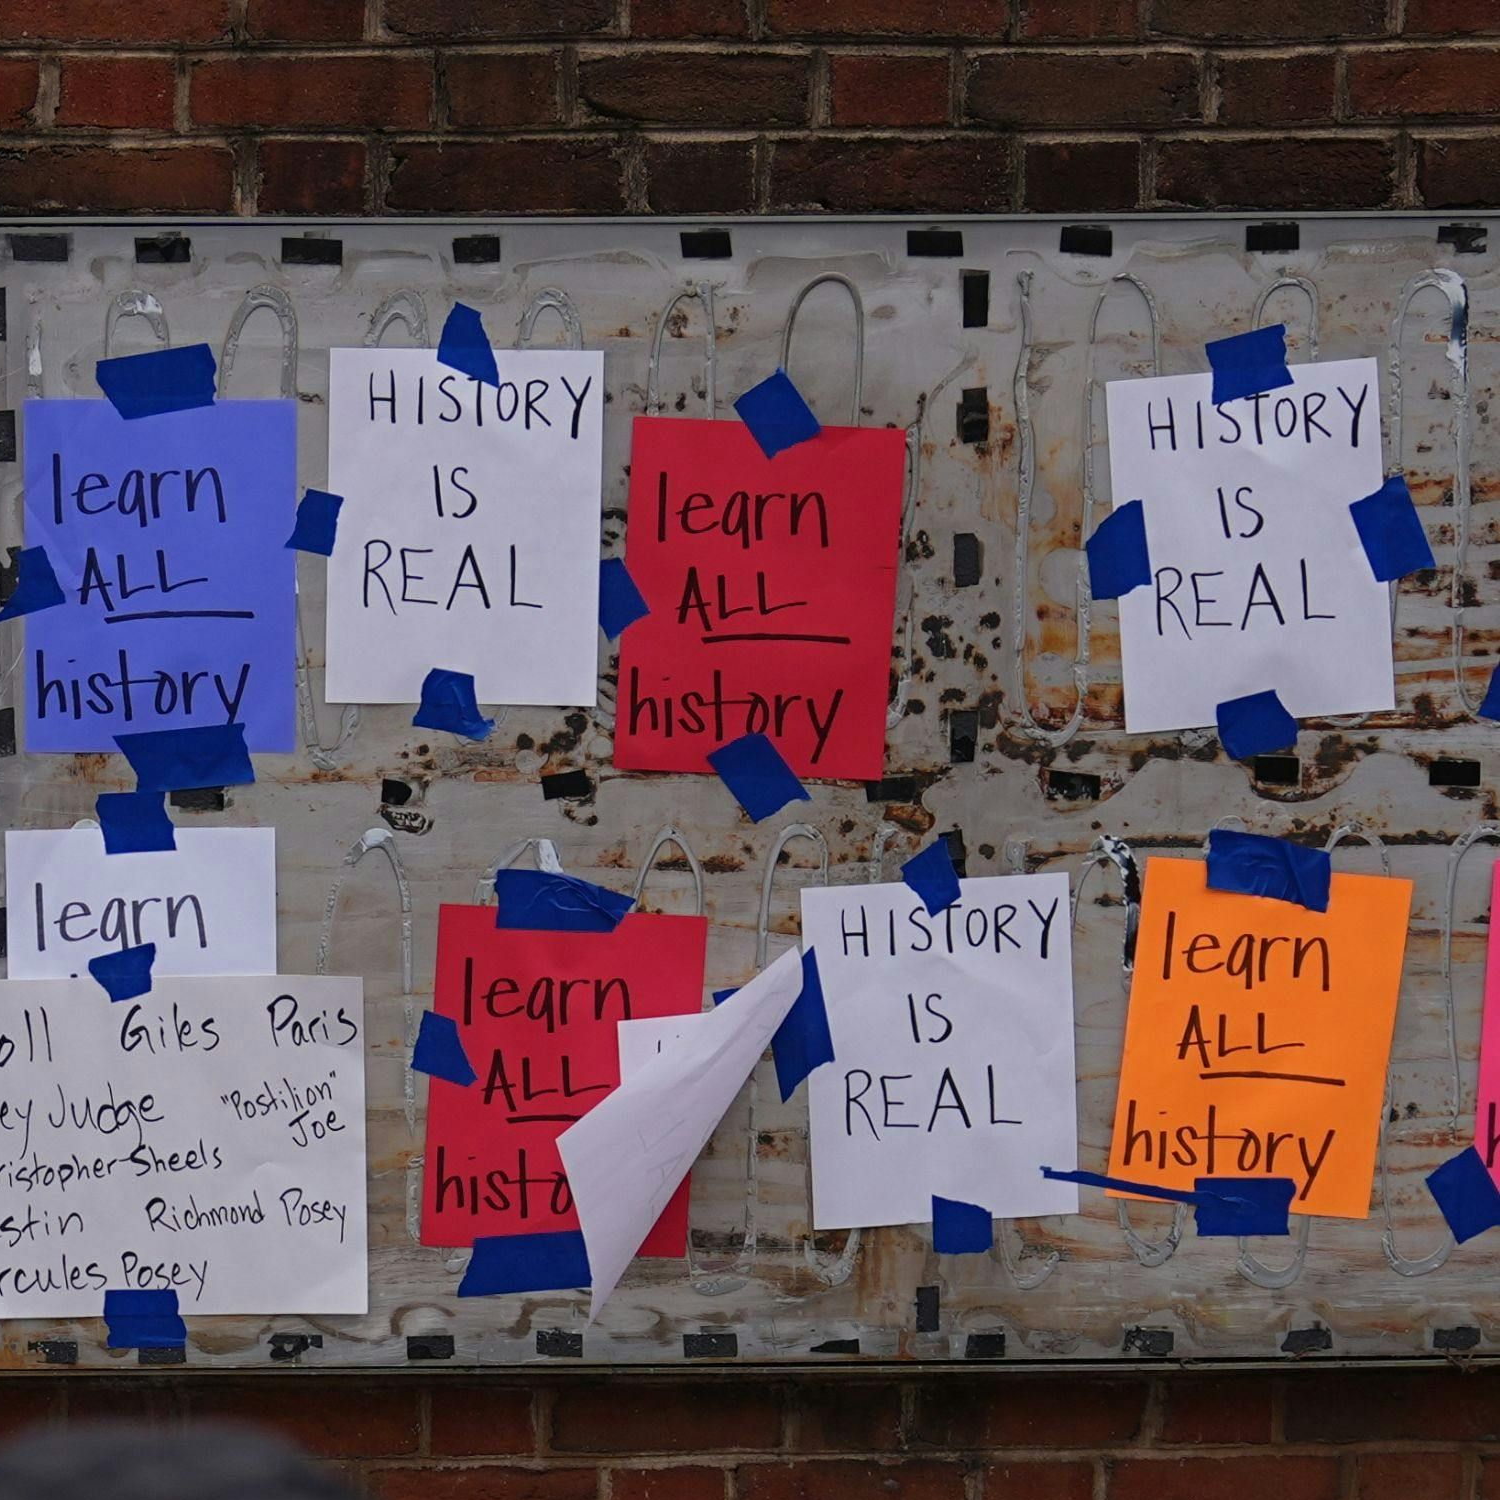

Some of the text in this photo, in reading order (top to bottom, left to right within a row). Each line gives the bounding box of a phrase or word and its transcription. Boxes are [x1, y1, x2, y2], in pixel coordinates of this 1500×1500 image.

[369, 372, 592, 438] HISTORY
[1148, 384, 1368, 450] HISTORY
[52, 454, 226, 527] learn
[434, 465, 477, 518] IS
[658, 473, 829, 549] learn
[1217, 487, 1263, 539] IS
[78, 549, 207, 611] ALL
[364, 539, 542, 614] REAL
[676, 568, 807, 630] ALL
[1156, 558, 1335, 638] REAL
[36, 650, 250, 724] history
[629, 666, 844, 764] history
[36, 883, 206, 950] learn
[841, 897, 1058, 959] HISTORY
[1163, 911, 1329, 992] learn
[267, 995, 357, 1046] Paris
[463, 957, 631, 1033] learn
[908, 993, 953, 1044] IS
[1175, 1004, 1304, 1068] ALL
[482, 1049, 611, 1112] ALL
[845, 1065, 1022, 1140] REAL
[48, 1083, 164, 1146] Judge
[289, 1111, 345, 1148] Joe
[436, 1147, 573, 1218] histo
[1123, 1100, 1335, 1201] history
[146, 1187, 346, 1243] Richmond Posey
[121, 1251, 211, 1300] Posey
